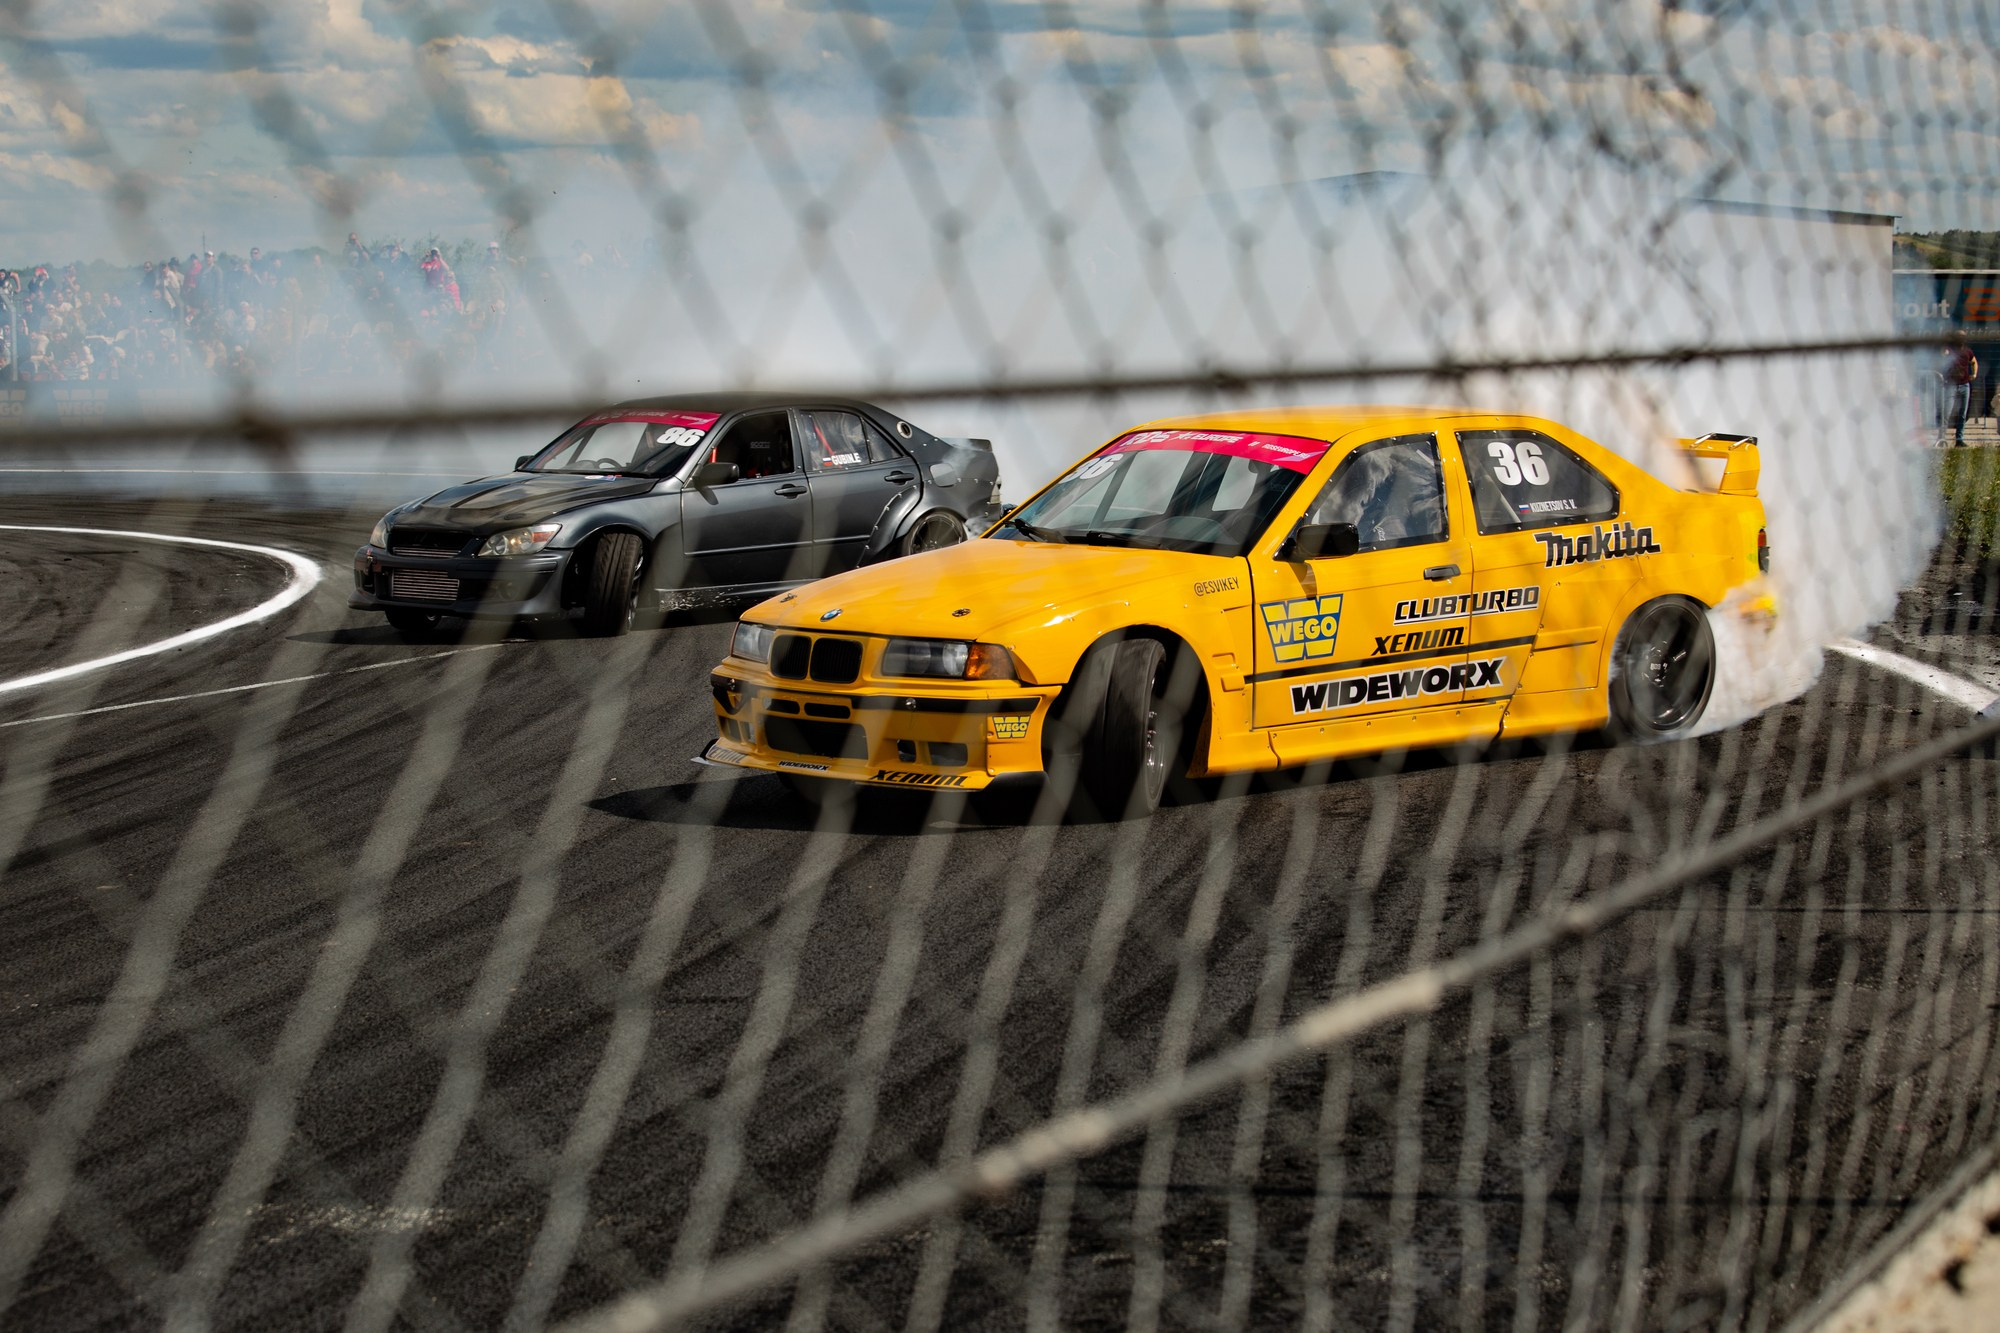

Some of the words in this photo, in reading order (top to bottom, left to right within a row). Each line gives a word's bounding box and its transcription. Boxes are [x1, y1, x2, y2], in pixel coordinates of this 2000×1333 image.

[657, 427, 705, 446] 86
[1487, 441, 1550, 486] 36
[1529, 500, 1564, 513] KUZNETSOV
[1193, 576, 1240, 597] @ESVIKEY
[1394, 586, 1540, 622] CLUBTURBO
[1269, 616, 1338, 644] WEGO
[1371, 627, 1466, 656] XENUM
[1290, 656, 1507, 716] WIDEWORX
[994, 721, 1028, 733] WEGO
[779, 760, 829, 771] WIDEWORX
[870, 768, 969, 788] XENUM
